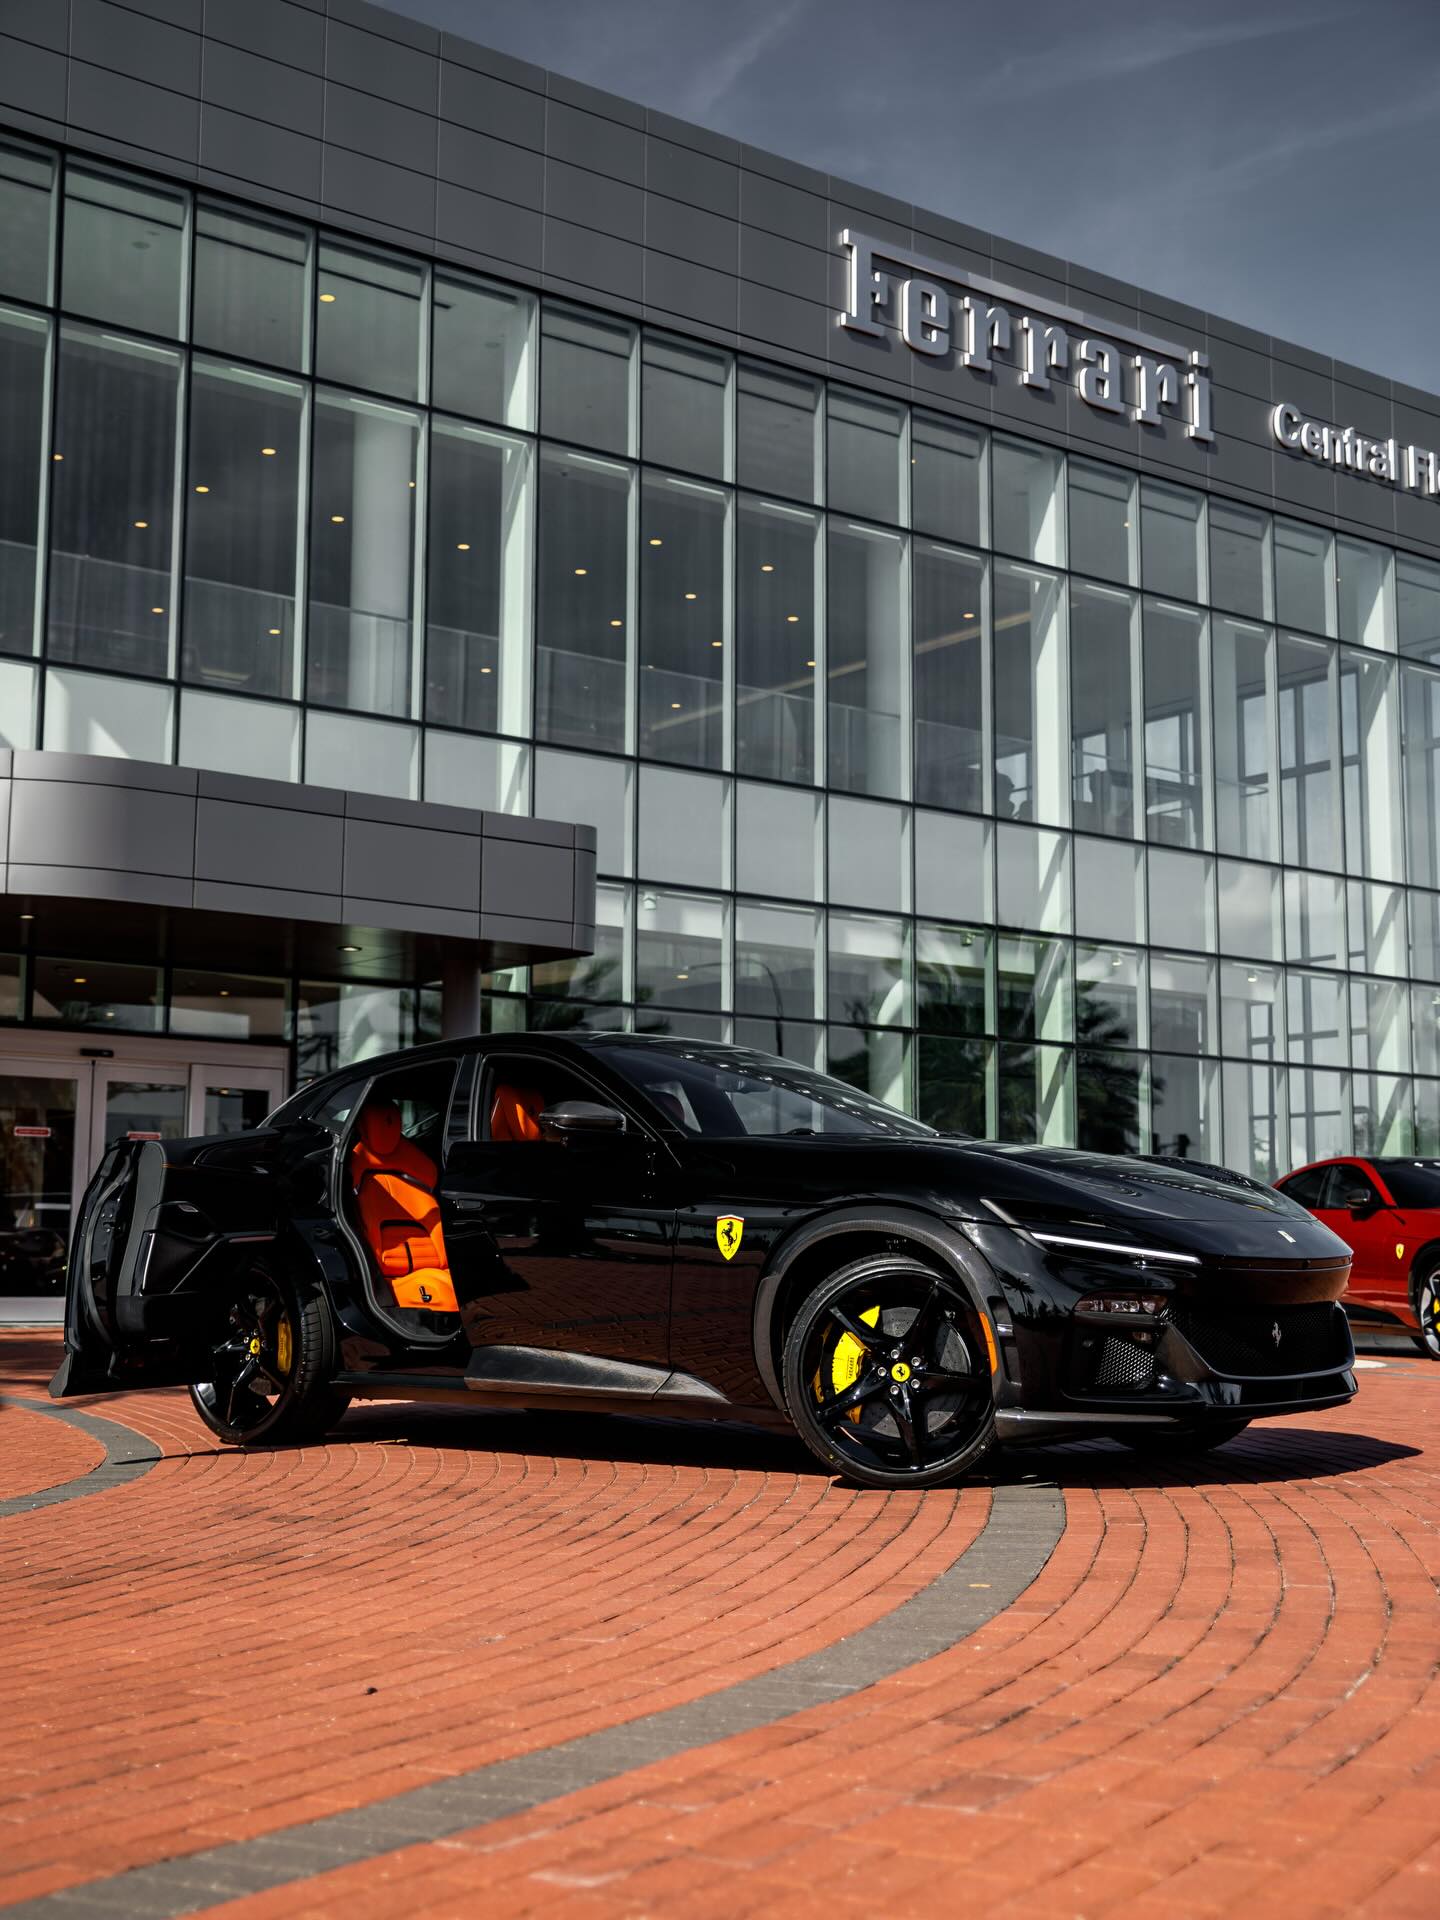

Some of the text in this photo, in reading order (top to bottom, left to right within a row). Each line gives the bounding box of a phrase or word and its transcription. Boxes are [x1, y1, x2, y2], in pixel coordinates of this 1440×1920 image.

[840, 228, 1214, 441] Ferrari
[1273, 403, 1440, 494] Central Fl
